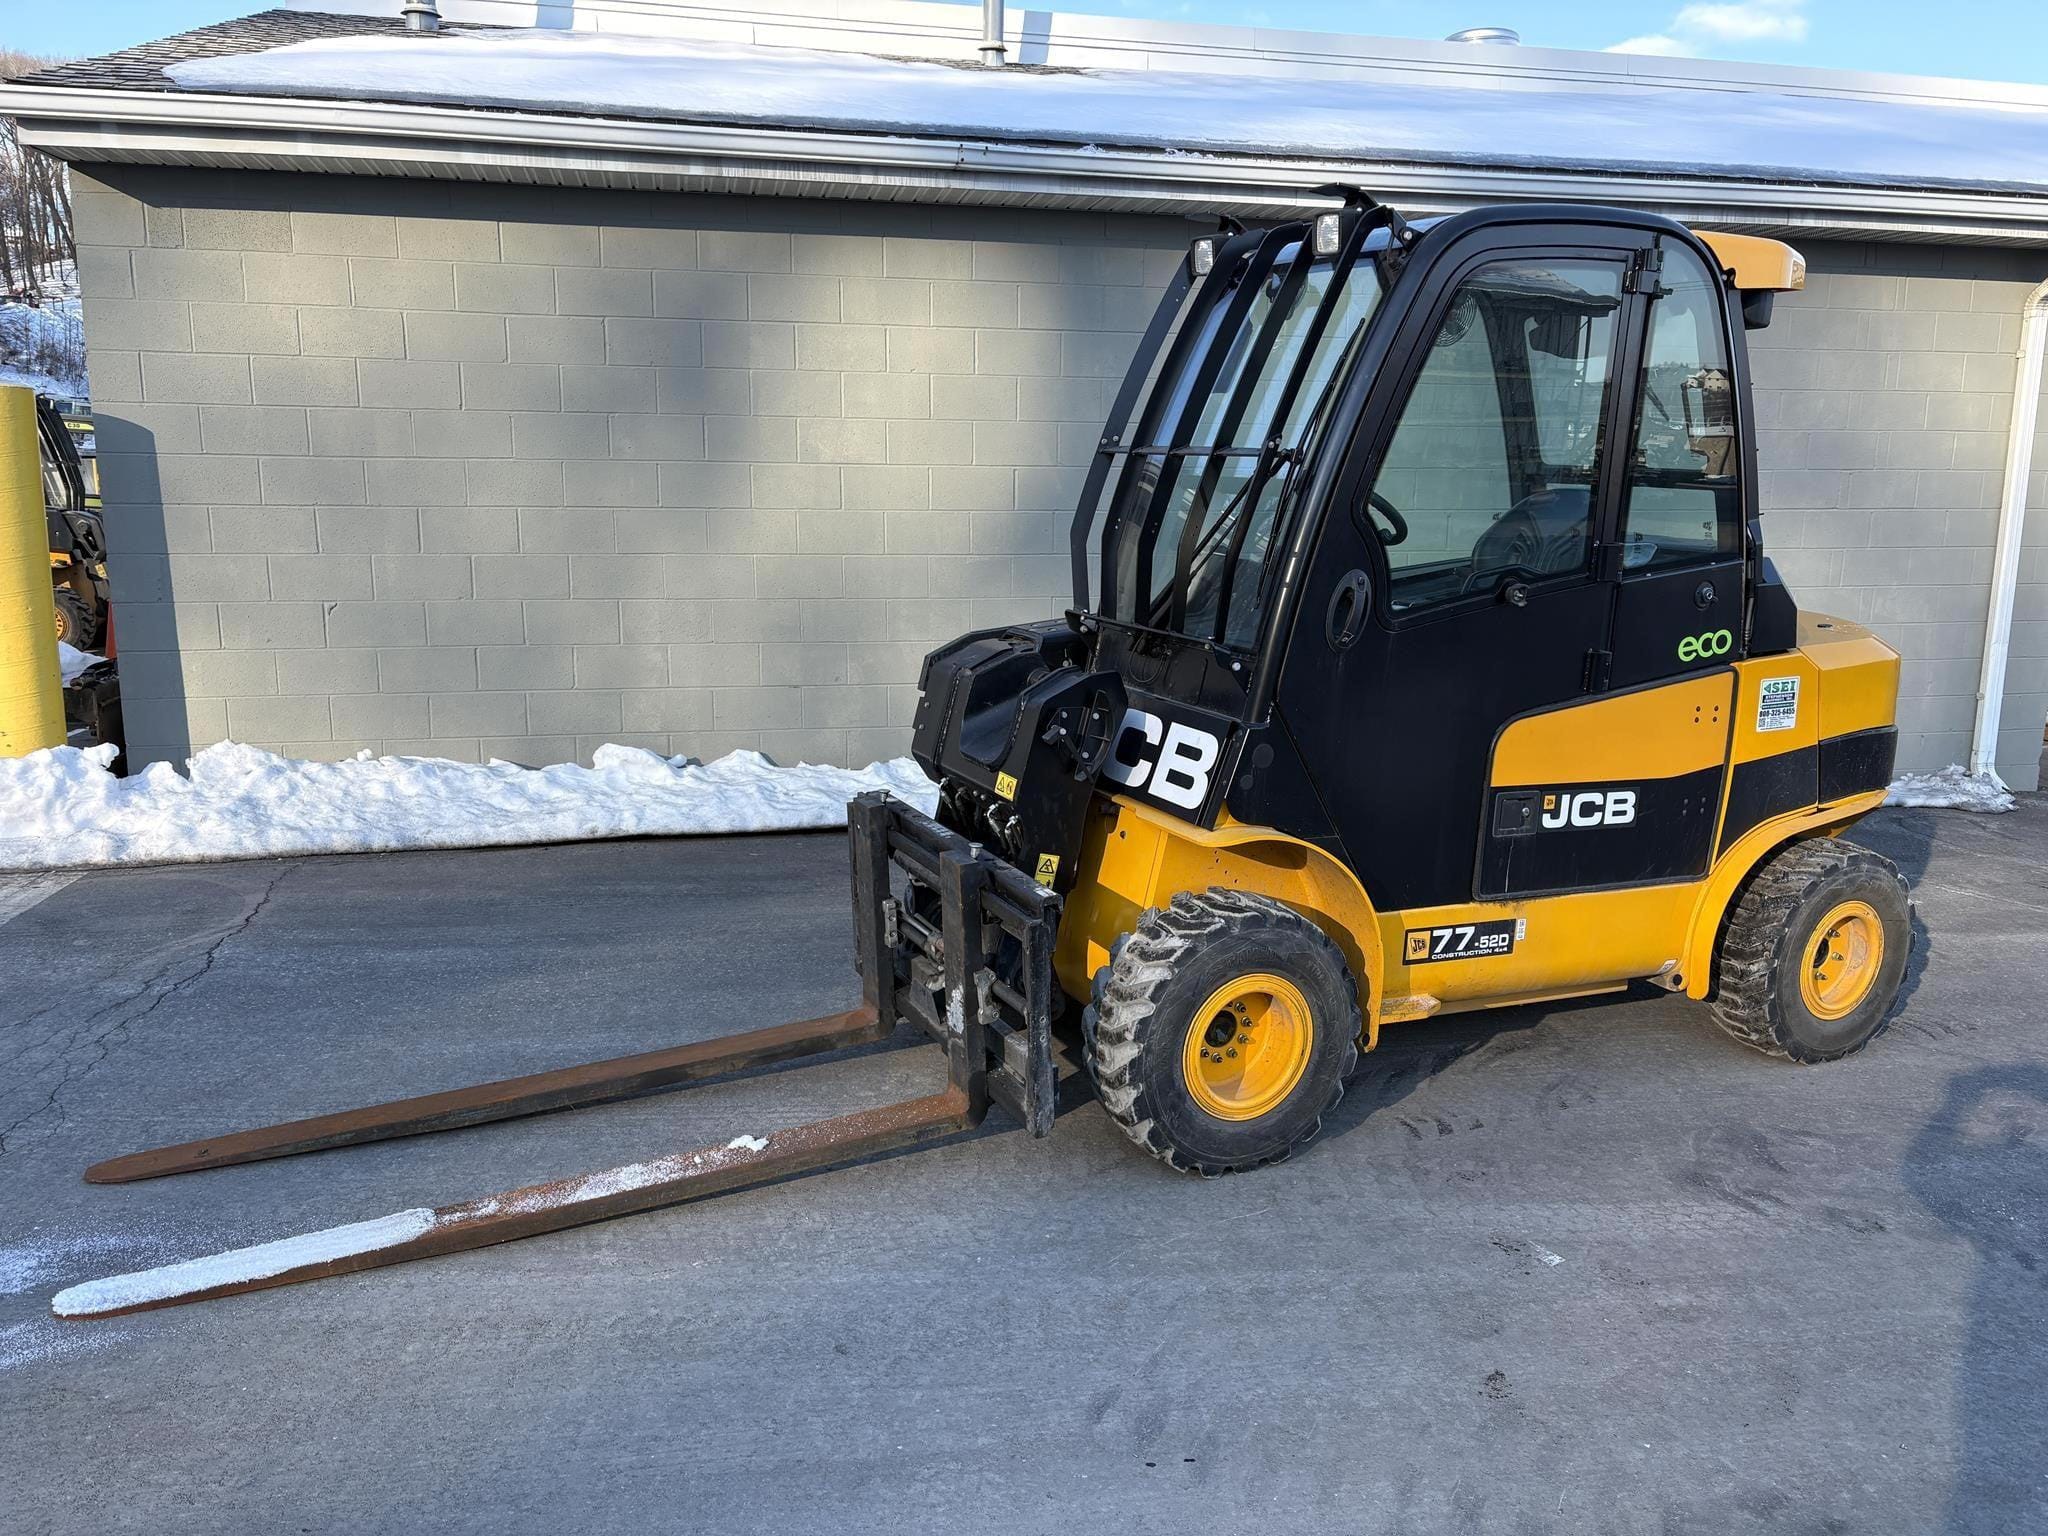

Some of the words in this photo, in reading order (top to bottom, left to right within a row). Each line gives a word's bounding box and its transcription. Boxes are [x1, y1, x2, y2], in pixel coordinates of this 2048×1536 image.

[1678, 629, 1733, 662] eco
[1772, 681, 1796, 693] SEI
[1102, 708, 1219, 810] CB
[1542, 791, 1636, 829] JCB
[1431, 948, 1493, 960] CONSTRUCTION
